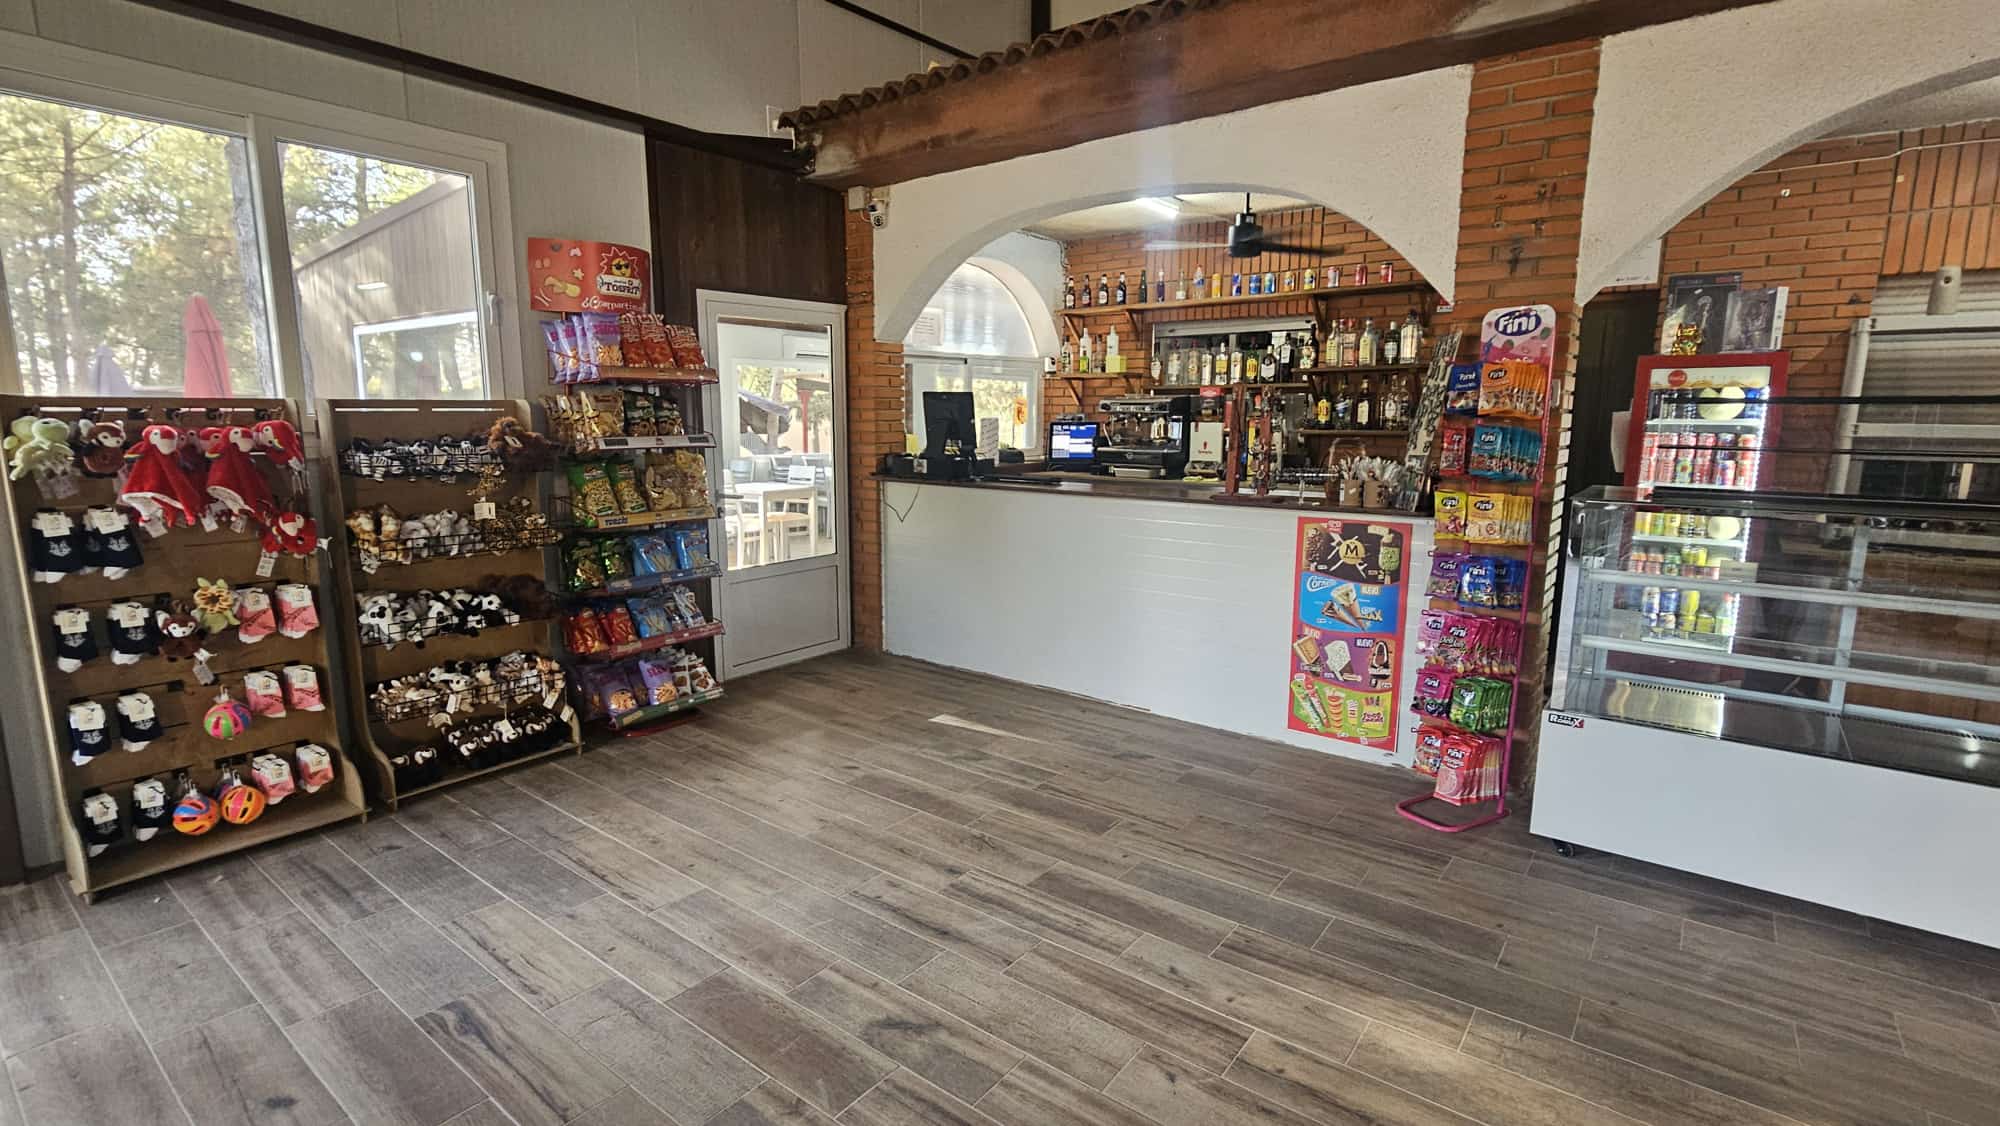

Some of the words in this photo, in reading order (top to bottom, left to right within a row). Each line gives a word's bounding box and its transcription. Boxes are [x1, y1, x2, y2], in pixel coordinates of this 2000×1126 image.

[1498, 311, 1538, 334] Fini
[1489, 368, 1506, 379] Fini
[1481, 432, 1497, 442] Fini
[1442, 496, 1459, 507] Fini
[1476, 500, 1493, 511] Fini
[1345, 544, 1359, 557] M
[1439, 561, 1457, 570] Fini
[1469, 565, 1486, 576] Fini
[1449, 626, 1467, 638] Fini
[1424, 677, 1439, 687] Fini
[1447, 748, 1465, 759] Fini
